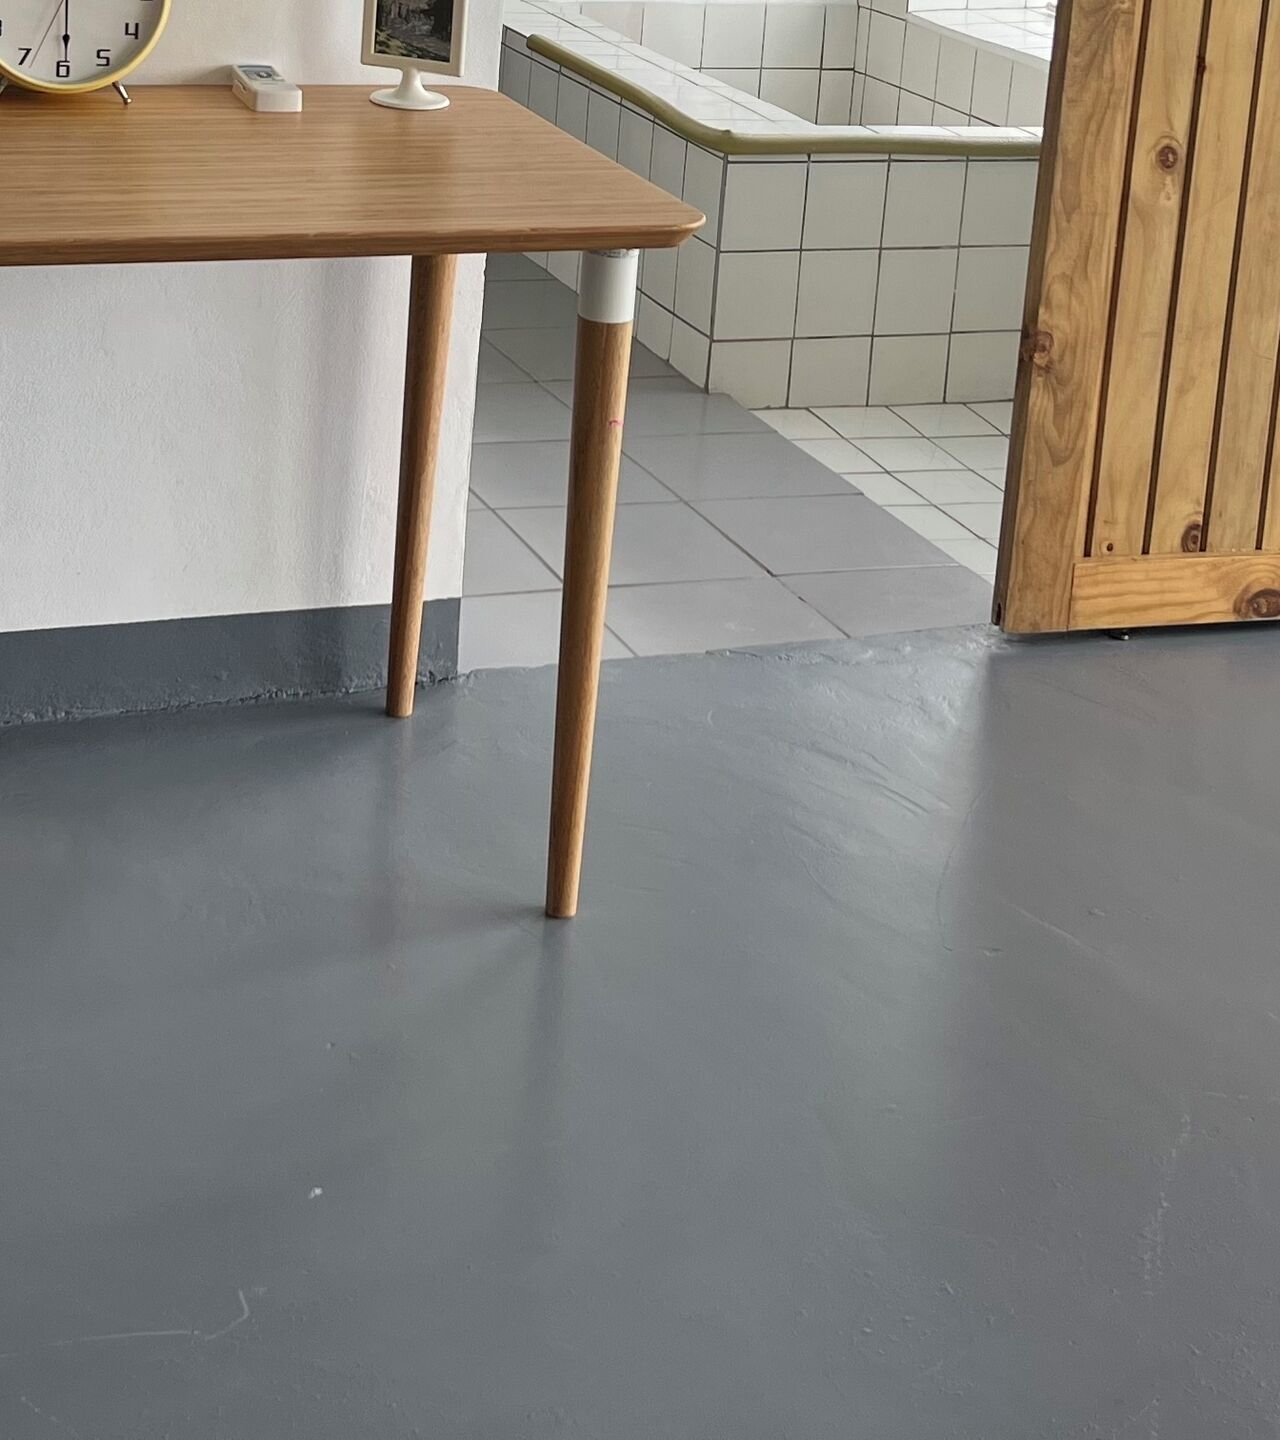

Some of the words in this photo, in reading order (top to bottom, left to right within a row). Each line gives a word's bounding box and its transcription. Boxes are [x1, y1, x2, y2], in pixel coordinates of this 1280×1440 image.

[125, 22, 139, 40] 4
[18, 47, 32, 65] 7
[96, 49, 111, 66] 5
[56, 60, 70, 78] 6
